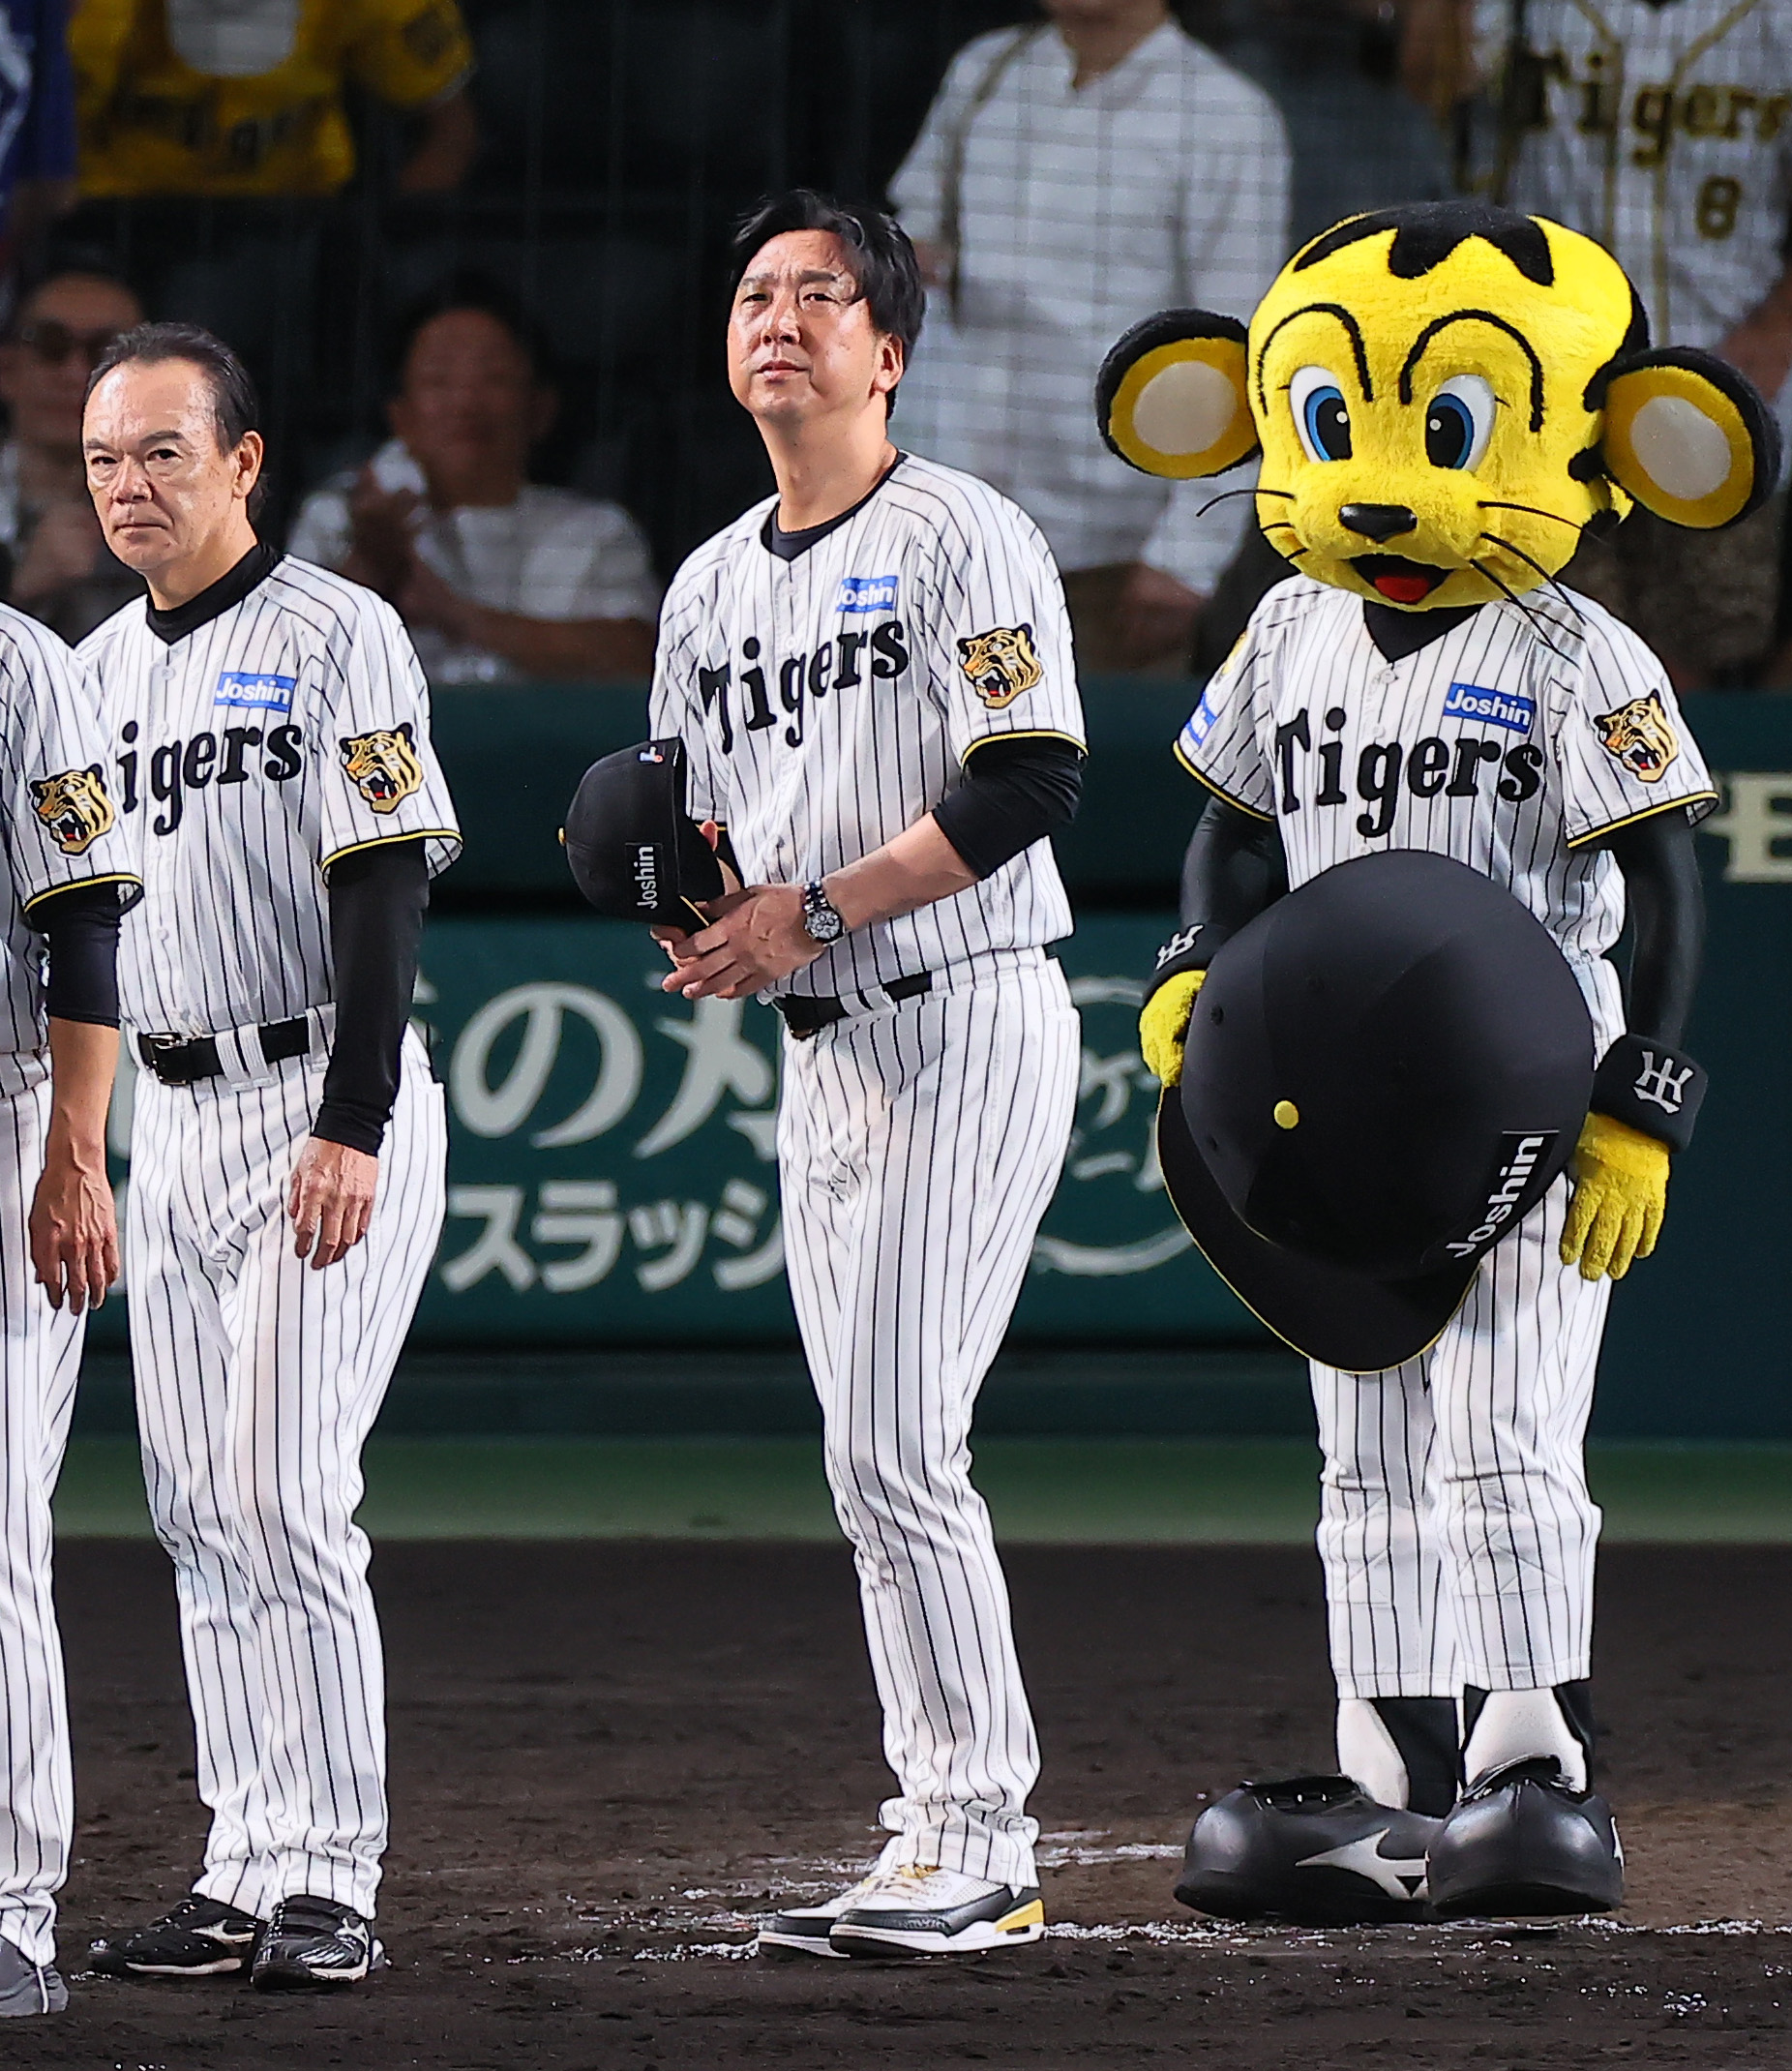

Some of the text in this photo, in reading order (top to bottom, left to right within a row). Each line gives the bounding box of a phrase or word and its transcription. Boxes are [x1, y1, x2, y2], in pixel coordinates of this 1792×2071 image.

[1695, 176, 1742, 242] 8
[216, 676, 291, 706] Joshin
[1446, 687, 1532, 727] Joshin
[117, 720, 302, 836] igers
[1275, 707, 1544, 837] Tigers
[634, 846, 660, 910] Joshin
[1446, 1136, 1544, 1258] Joshin
